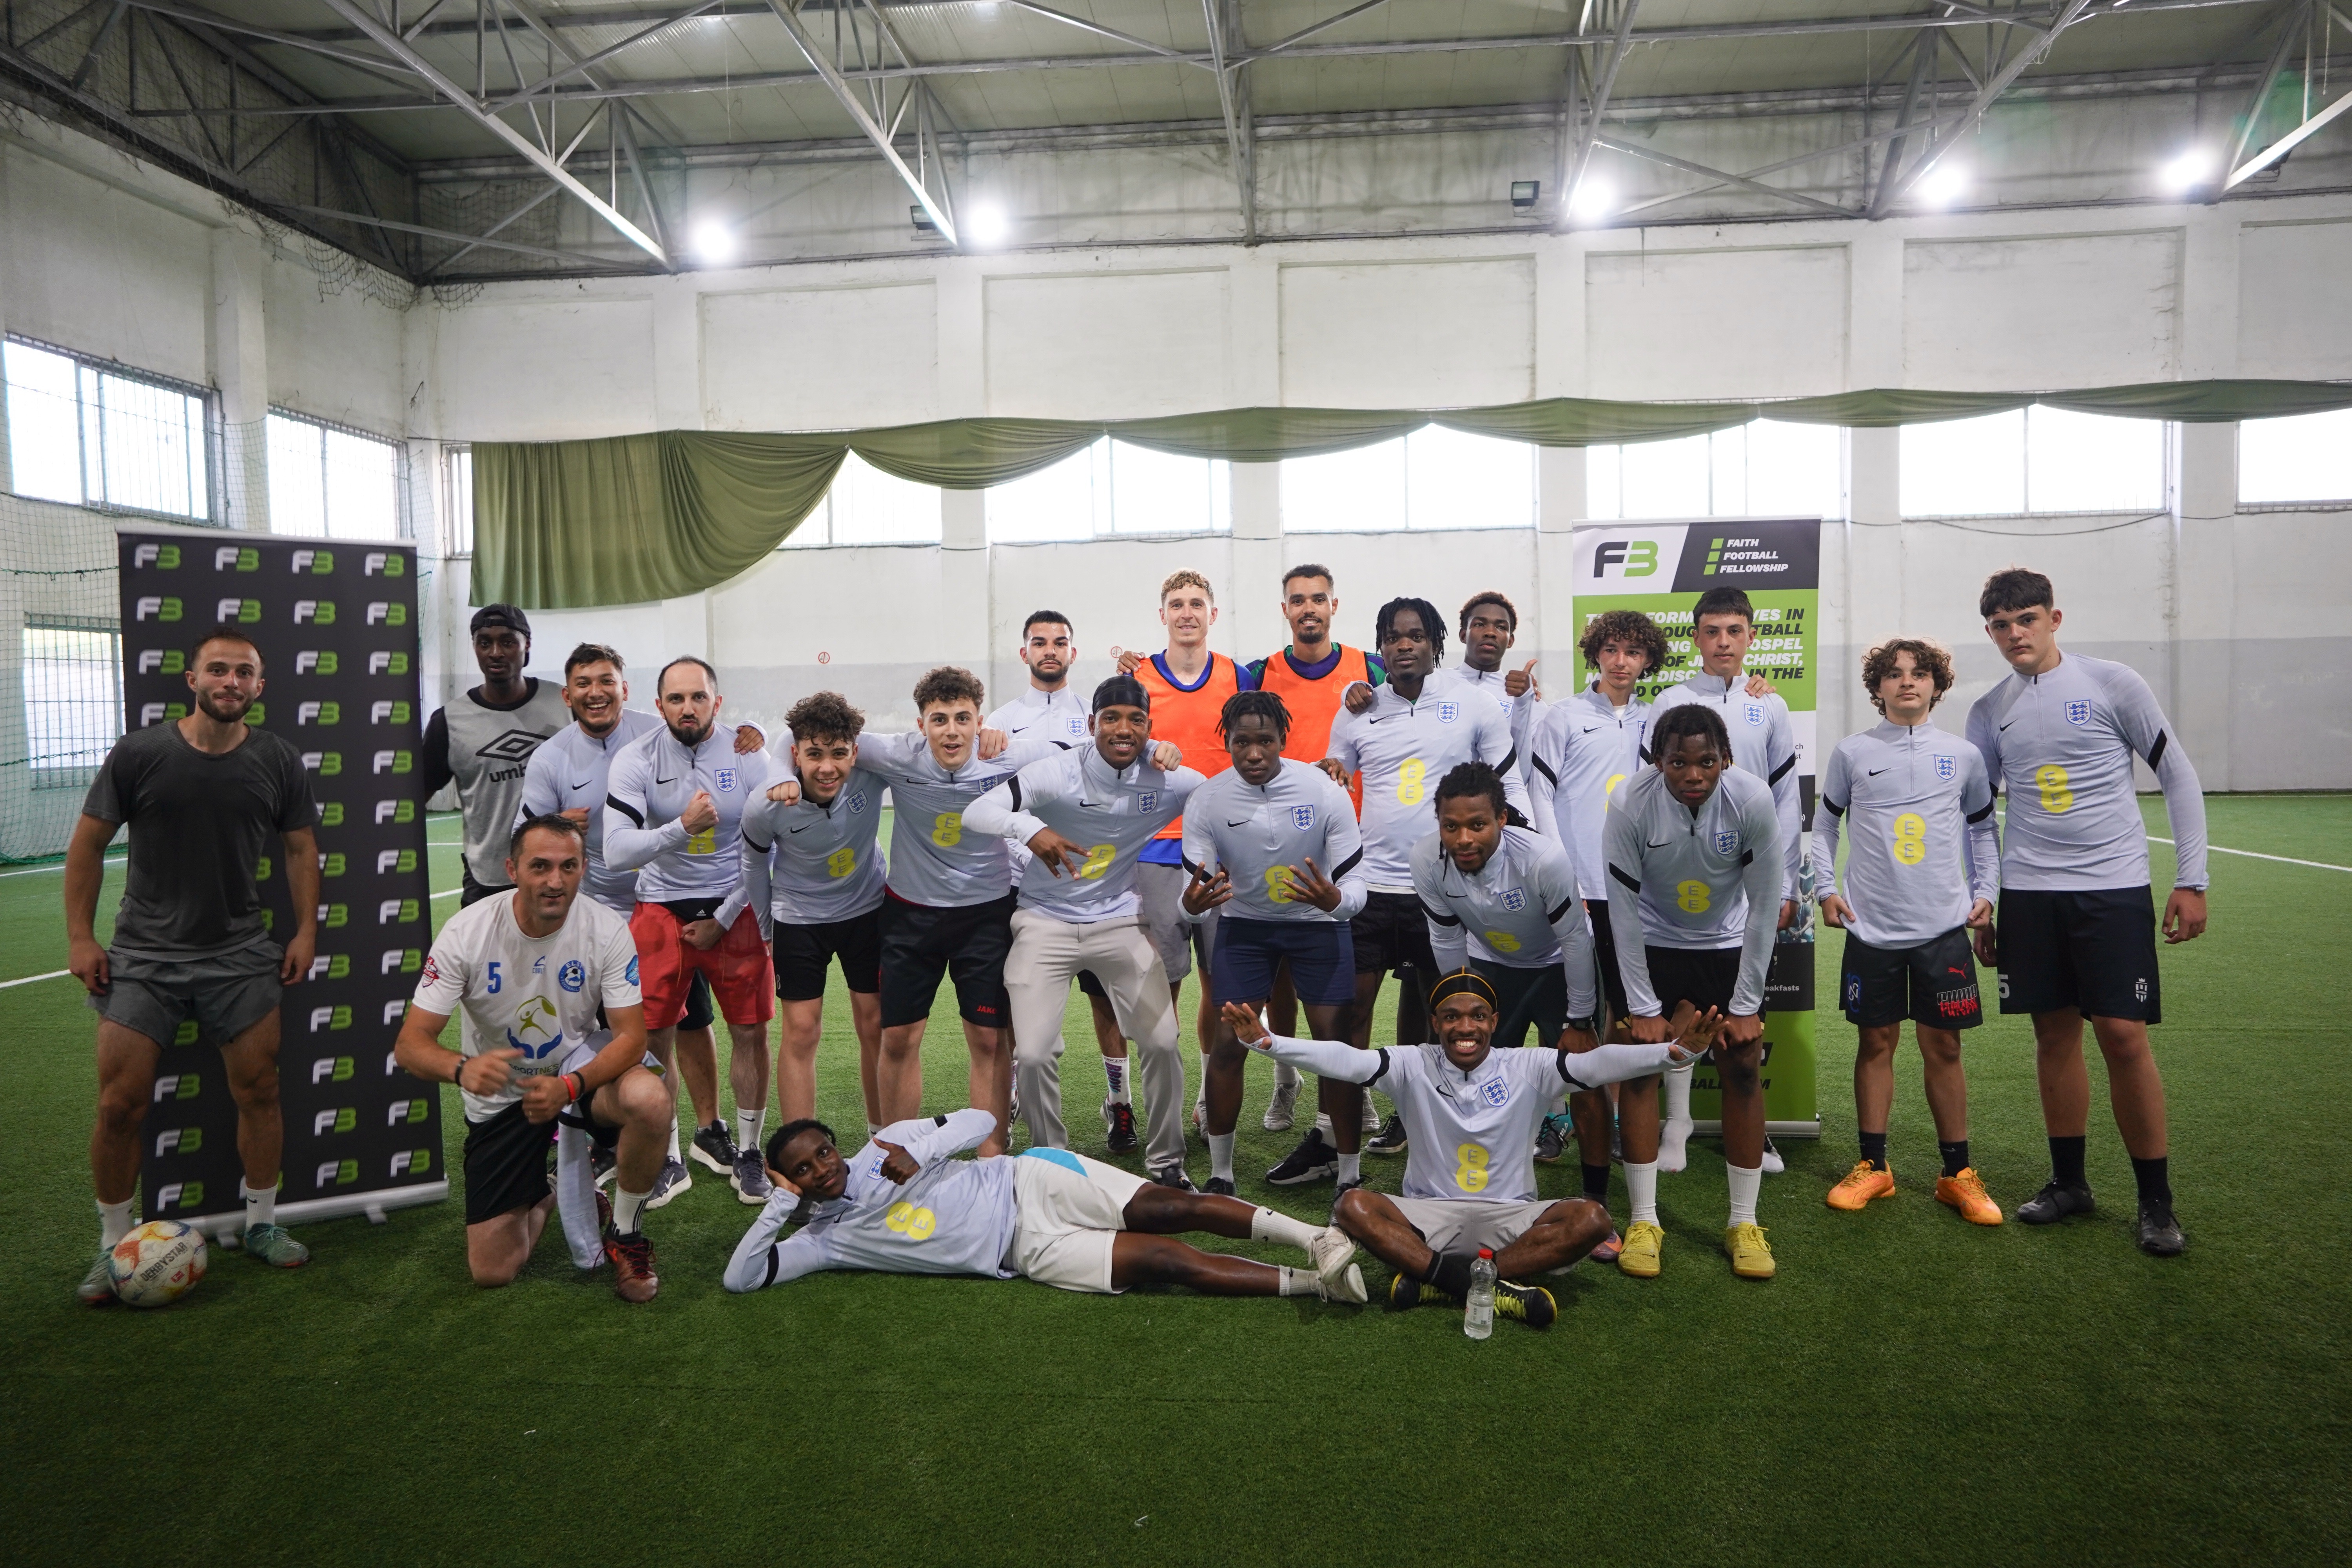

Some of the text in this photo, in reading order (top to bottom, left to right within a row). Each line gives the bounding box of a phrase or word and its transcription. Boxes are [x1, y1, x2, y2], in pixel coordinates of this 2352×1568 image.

[1727, 539, 1759, 547] FAITH
[1723, 551, 1779, 560] FOOTBALL
[1720, 563, 1789, 573] FELLOWSHIP
[1786, 608, 1804, 620] IN
[1751, 623, 1803, 635] TBALL
[1748, 638, 1803, 651] OSPEL
[1665, 655, 1687, 667] OF
[1742, 653, 1803, 666] CHRIST,
[1772, 667, 1804, 679] THE
[489, 765, 526, 783] umb
[488, 962, 501, 994] 5
[1937, 984, 1977, 1005] PUMA
[140, 1242, 188, 1281] DERBYSTAR
